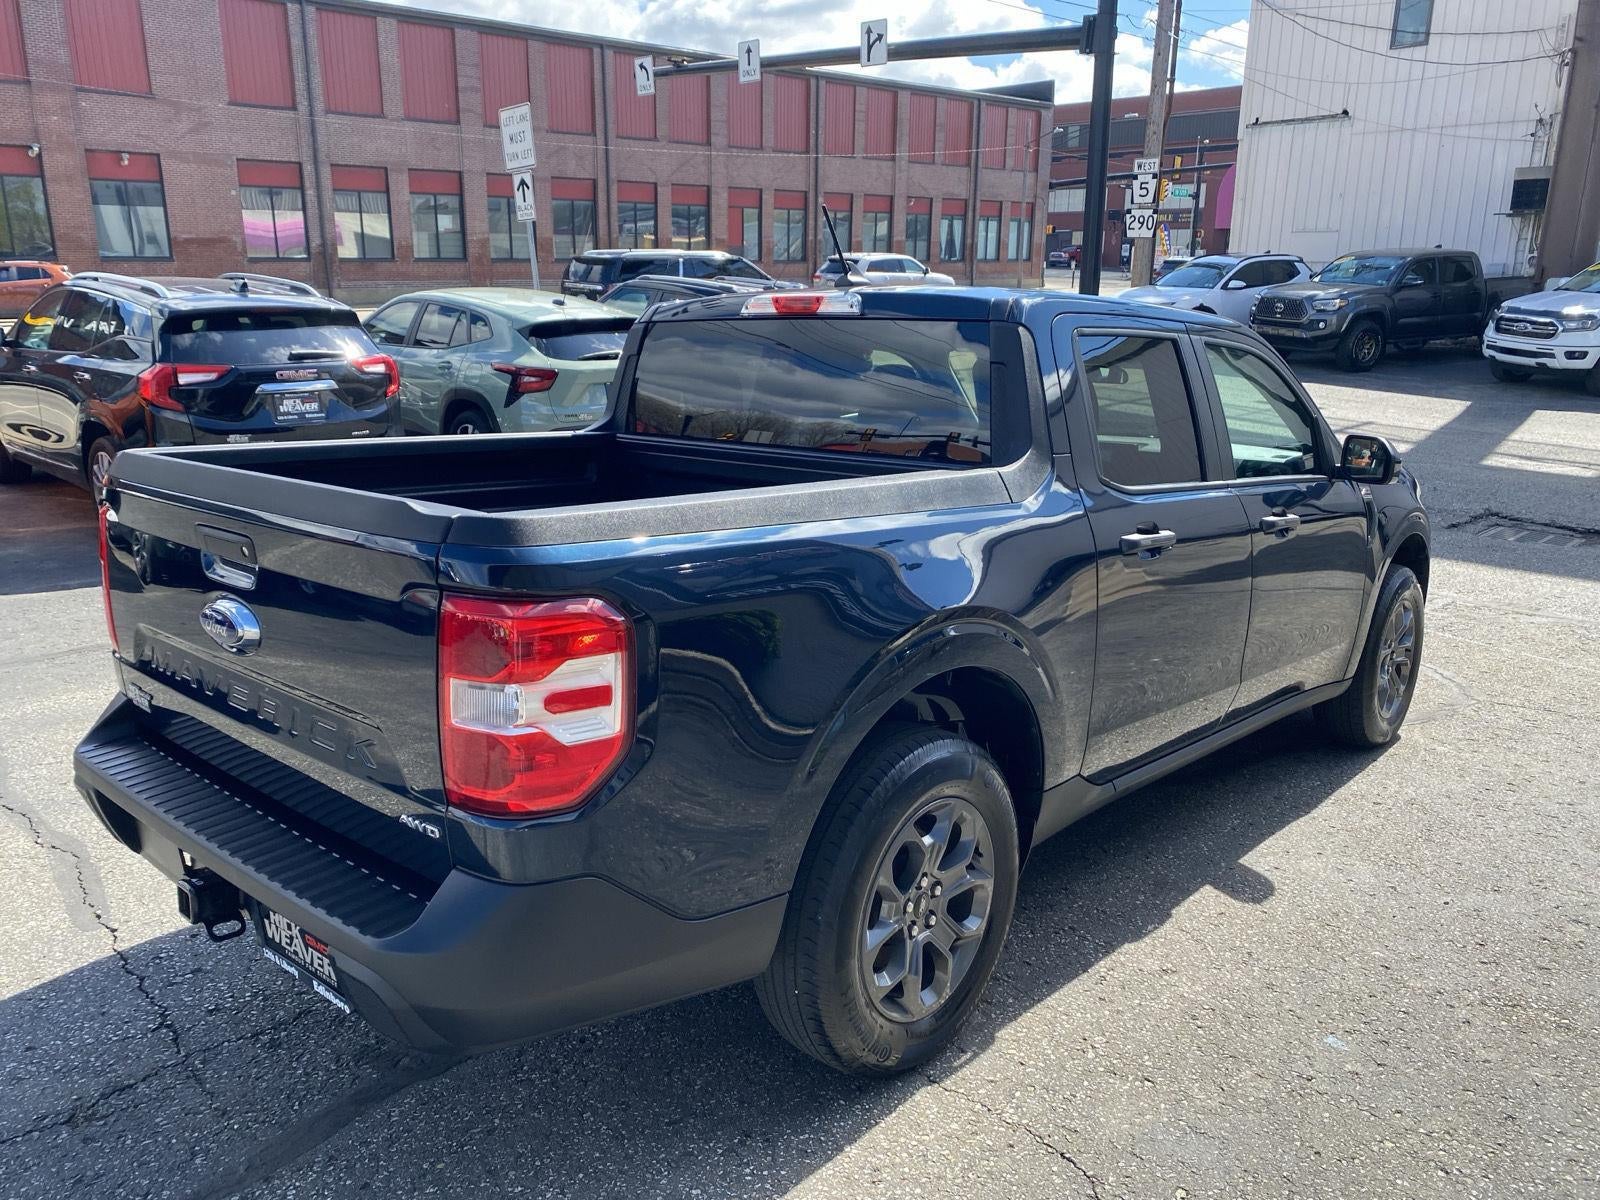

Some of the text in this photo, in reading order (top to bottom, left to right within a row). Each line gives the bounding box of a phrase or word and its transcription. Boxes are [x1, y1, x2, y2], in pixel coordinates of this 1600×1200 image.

[742, 68, 756, 78] ONLY
[640, 84, 652, 92] ONLY
[502, 112, 529, 128] LEFT LANE
[509, 130, 526, 145] MUST
[507, 149, 533, 163] TURN LEFT
[1137, 161, 1156, 171] WEST
[1139, 182, 1149, 197] 5
[517, 203, 533, 213] BLACK
[1128, 214, 1155, 231] 290
[276, 369, 318, 379] GMC
[279, 402, 319, 412] WEAVER
[151, 646, 378, 769] MAVERICK
[399, 814, 440, 838] AWD
[264, 918, 337, 982] WEAVER
[304, 933, 329, 955] GMC
[312, 979, 350, 1014] Edinboro
